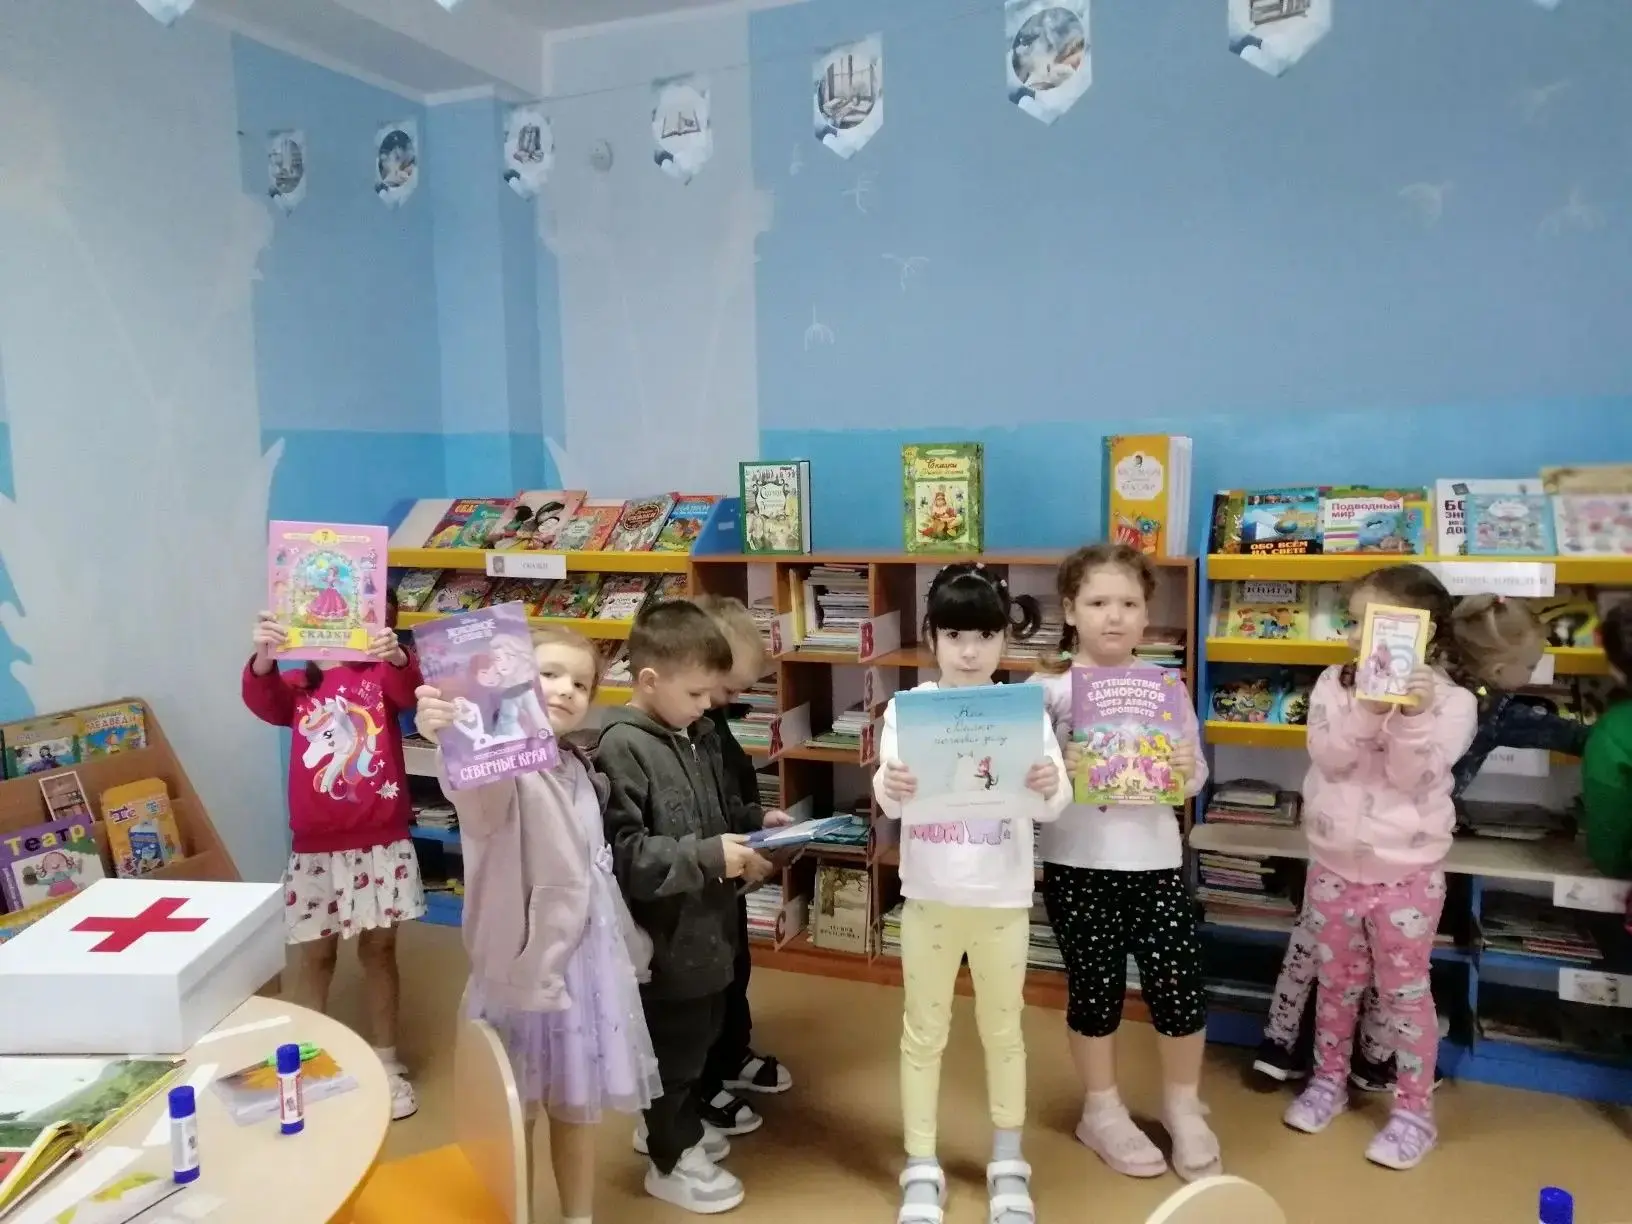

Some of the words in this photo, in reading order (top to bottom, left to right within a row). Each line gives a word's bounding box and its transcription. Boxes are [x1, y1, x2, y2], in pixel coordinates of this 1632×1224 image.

[1331, 502, 1400, 511] Подводный
[1331, 511, 1355, 519] мир
[1246, 586, 1293, 595] КНИГА
[860, 622, 874, 659] В
[1091, 677, 1161, 691] ПУТЕШЕСТВИЕ
[1087, 686, 1166, 702] ЕДИНОРОГОВ
[1100, 706, 1155, 718] КОРОЛЕВСТВ
[460, 754, 517, 781] СЕВЕРНЫЕ
[518, 747, 548, 768] КРАЯ
[3, 824, 86, 857] Театр
